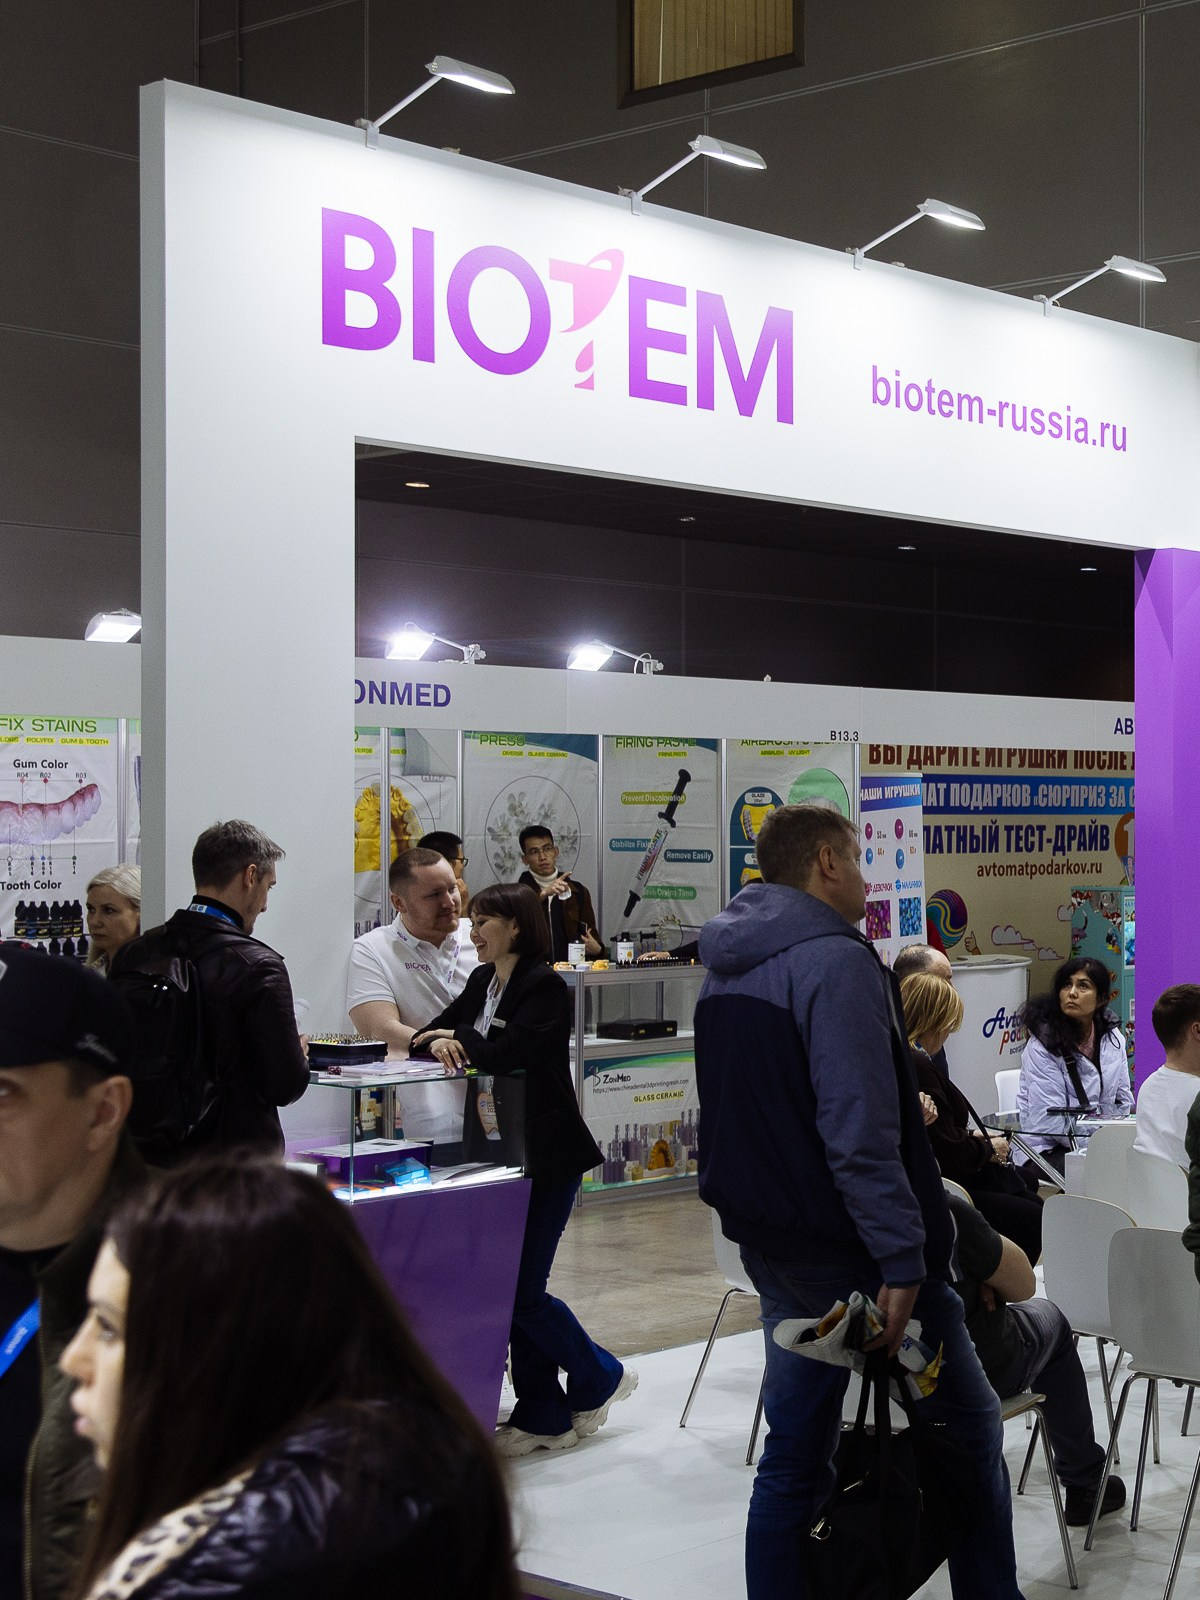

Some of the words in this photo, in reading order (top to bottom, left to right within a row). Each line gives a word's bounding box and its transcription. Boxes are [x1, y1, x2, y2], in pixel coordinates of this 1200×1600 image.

[322, 207, 793, 425] BIOTEM
[872, 365, 1127, 452] biotem-russia.ru
[354, 679, 452, 708] ONMED
[0, 717, 25, 731] FIX
[31, 718, 98, 734] STAINS
[1113, 717, 1134, 735] АВ
[479, 733, 526, 747] PRESS
[615, 736, 654, 749] FIRING
[656, 736, 697, 747] PASTE
[830, 730, 859, 742] B13.3
[13, 759, 38, 769] Gum
[41, 759, 69, 769] Color
[906, 745, 980, 770] ДАРИТЕ
[984, 746, 1068, 770] ИГРУШКИ
[884, 783, 921, 800] ИГРУШКИ
[949, 783, 1031, 811] ПОДАРКОВ
[1109, 785, 1126, 808] ЗА
[1004, 818, 1110, 856] ТЕСТ-ДРАЙВ
[666, 851, 691, 860] Remove
[692, 851, 712, 862] Easily
[976, 858, 1103, 879] avtomatpodarkov.ru
[0, 880, 31, 891] Tooth
[34, 880, 62, 890] Color
[634, 1094, 655, 1103] GLASS
[656, 1090, 685, 1100] CERAMIC
